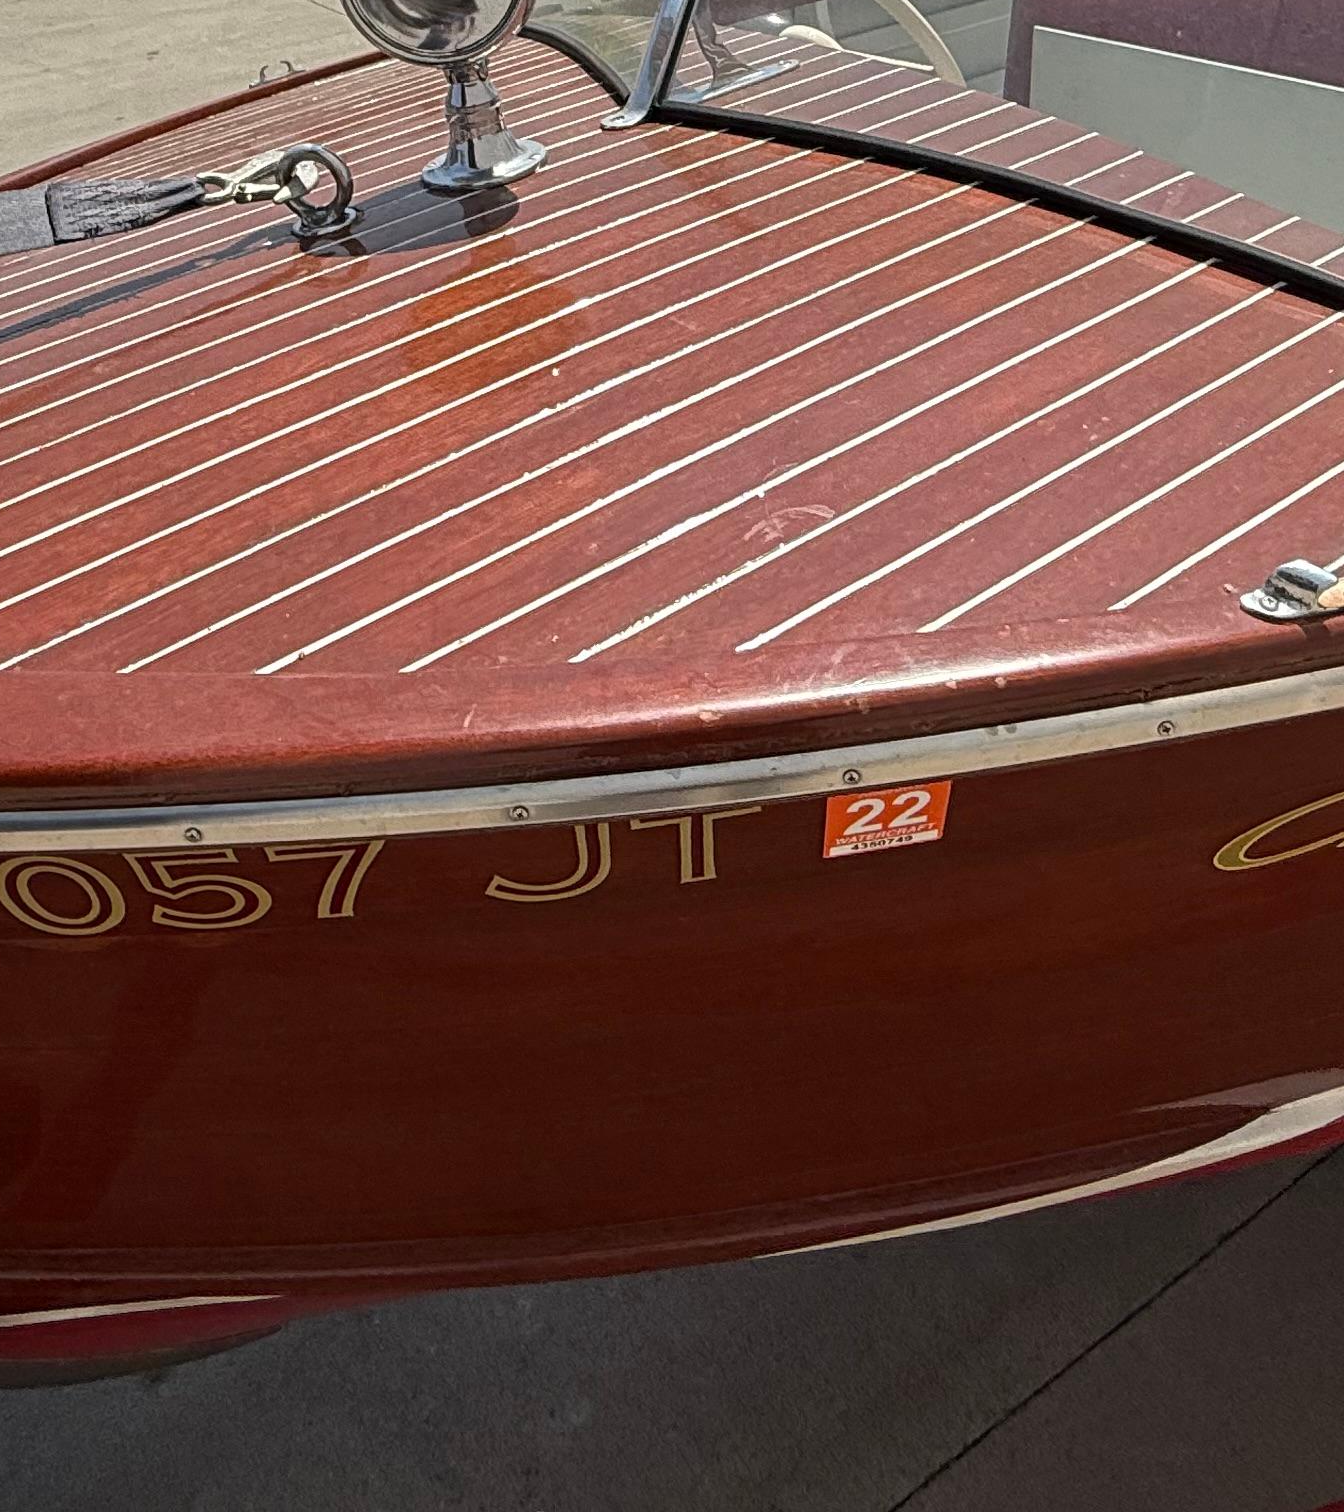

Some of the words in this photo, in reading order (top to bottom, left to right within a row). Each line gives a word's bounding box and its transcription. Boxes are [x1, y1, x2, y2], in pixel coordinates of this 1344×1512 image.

[835, 822, 937, 845] WATERCRAFT
[842, 790, 932, 837] 22
[484, 805, 763, 903] JT
